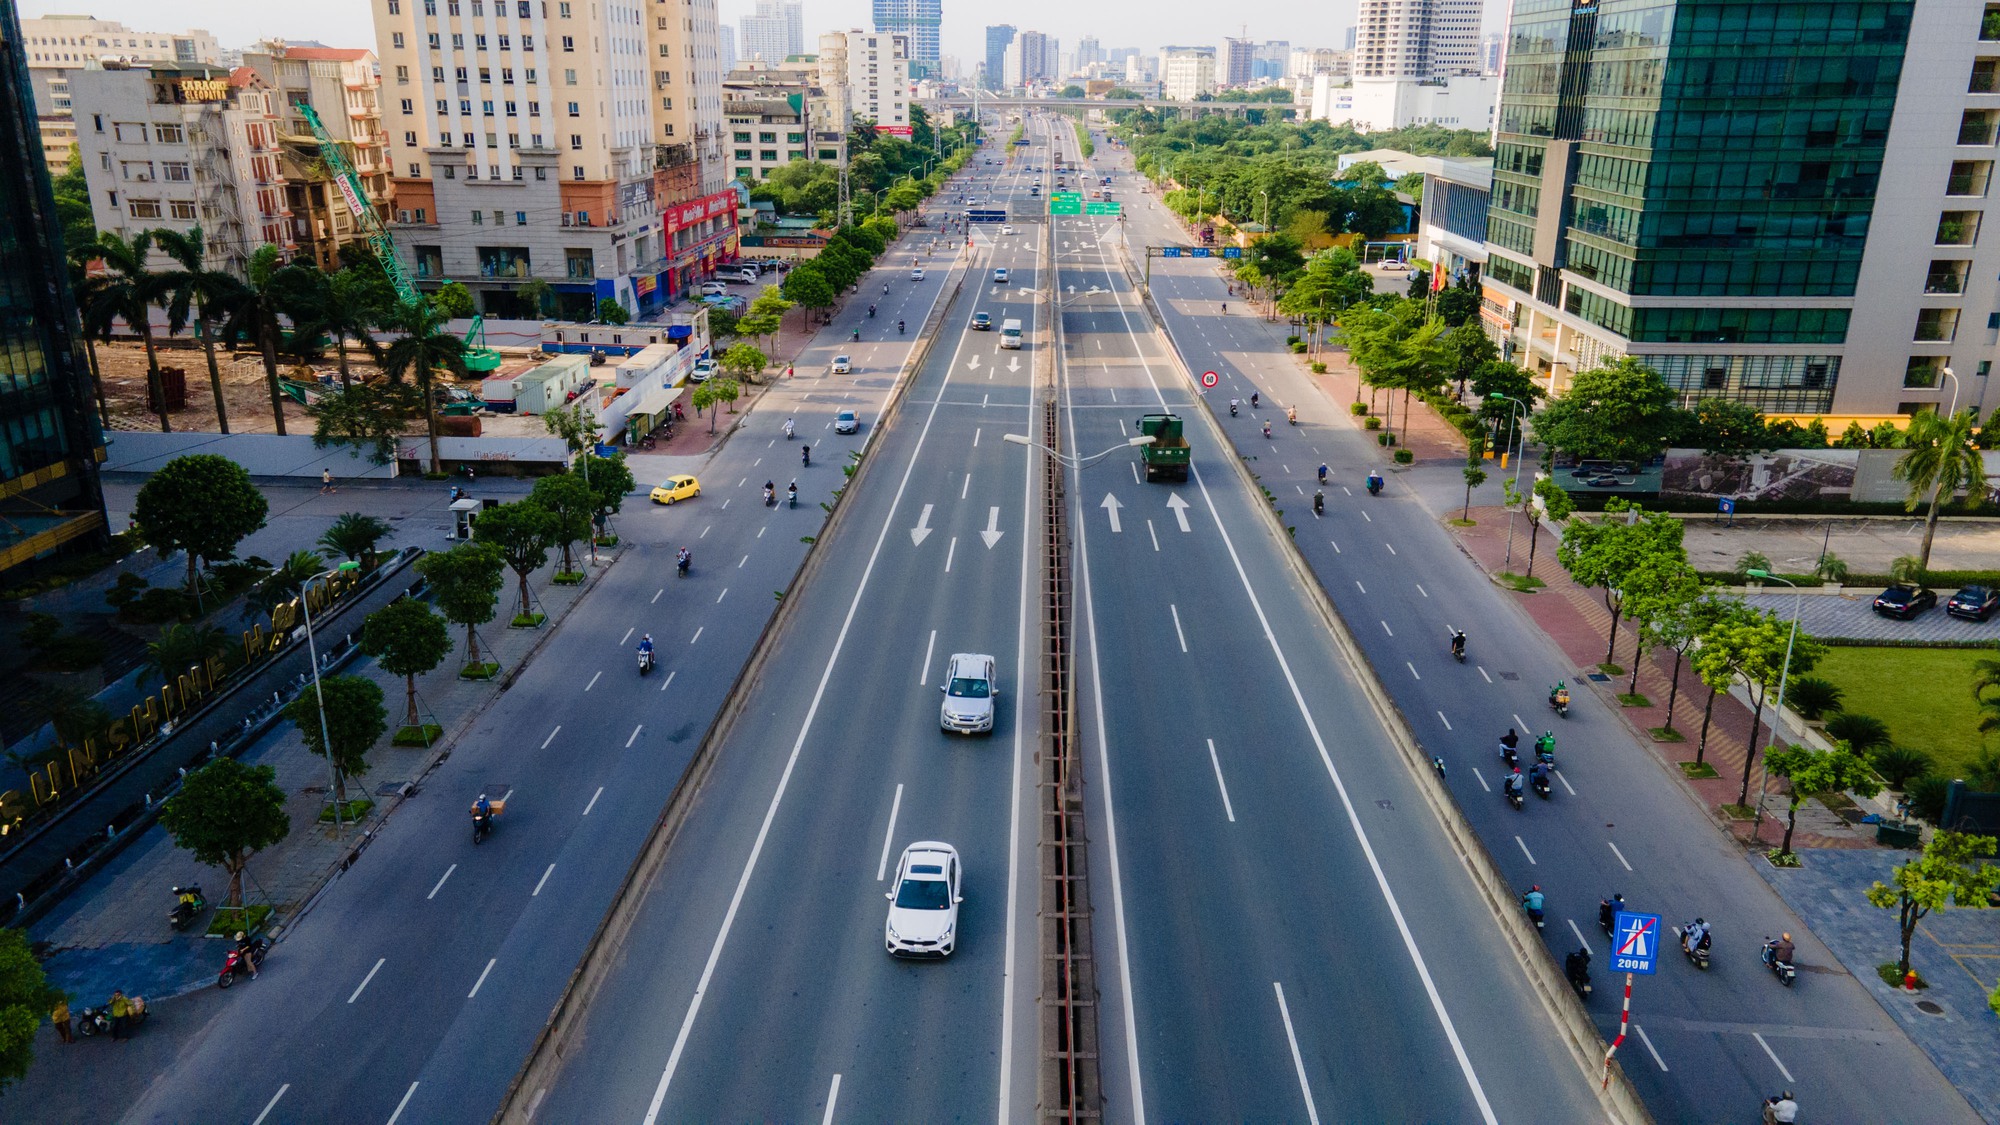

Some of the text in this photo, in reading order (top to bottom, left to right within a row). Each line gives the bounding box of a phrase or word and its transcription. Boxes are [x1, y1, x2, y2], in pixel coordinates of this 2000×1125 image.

[181, 80, 229, 91] KARAOKE
[184, 90, 227, 100] CLEOPATRA
[232, 122, 260, 248] KARAOK
[1206, 375, 1214, 383] 60
[0, 654, 226, 835] SUNSHINE
[1617, 958, 1649, 970] 200M
